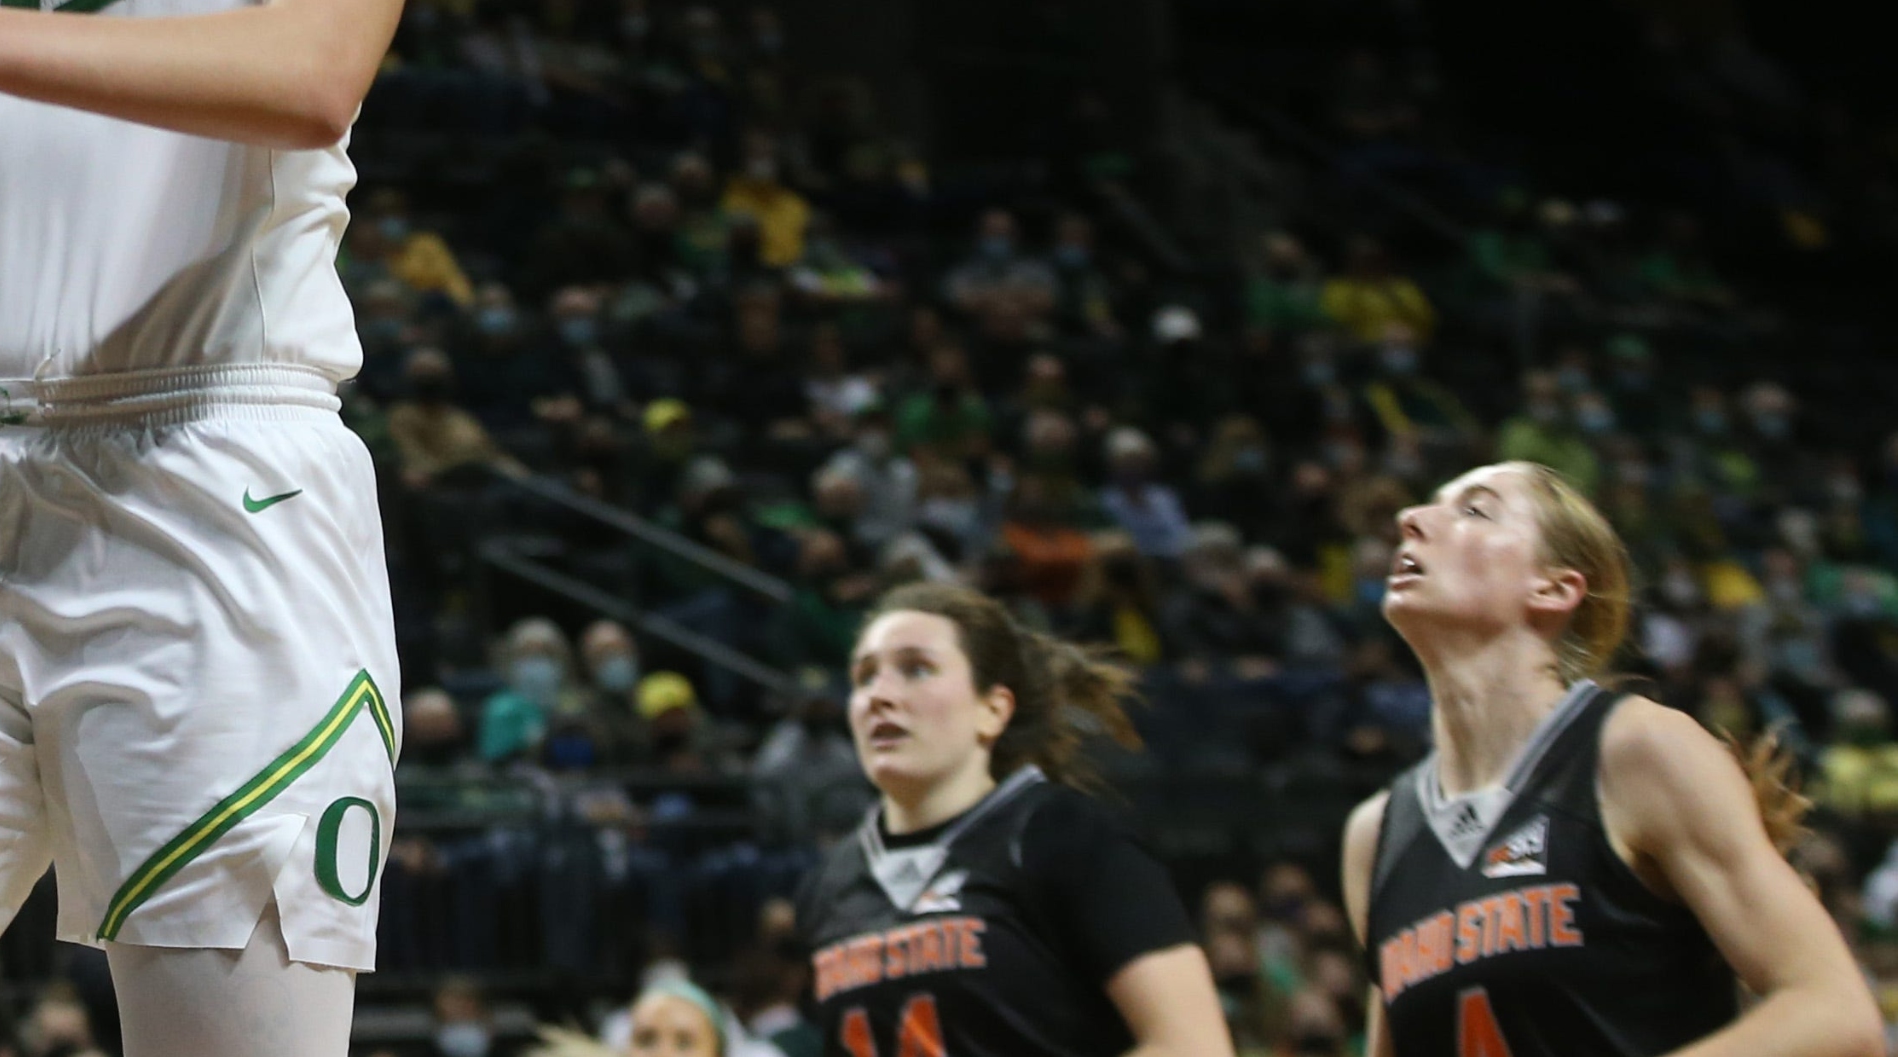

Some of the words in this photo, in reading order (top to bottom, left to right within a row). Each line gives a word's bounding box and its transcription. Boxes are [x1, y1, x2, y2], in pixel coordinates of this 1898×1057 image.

[314, 791, 380, 907] O
[885, 915, 988, 980] STATE
[1454, 882, 1584, 965] STATE
